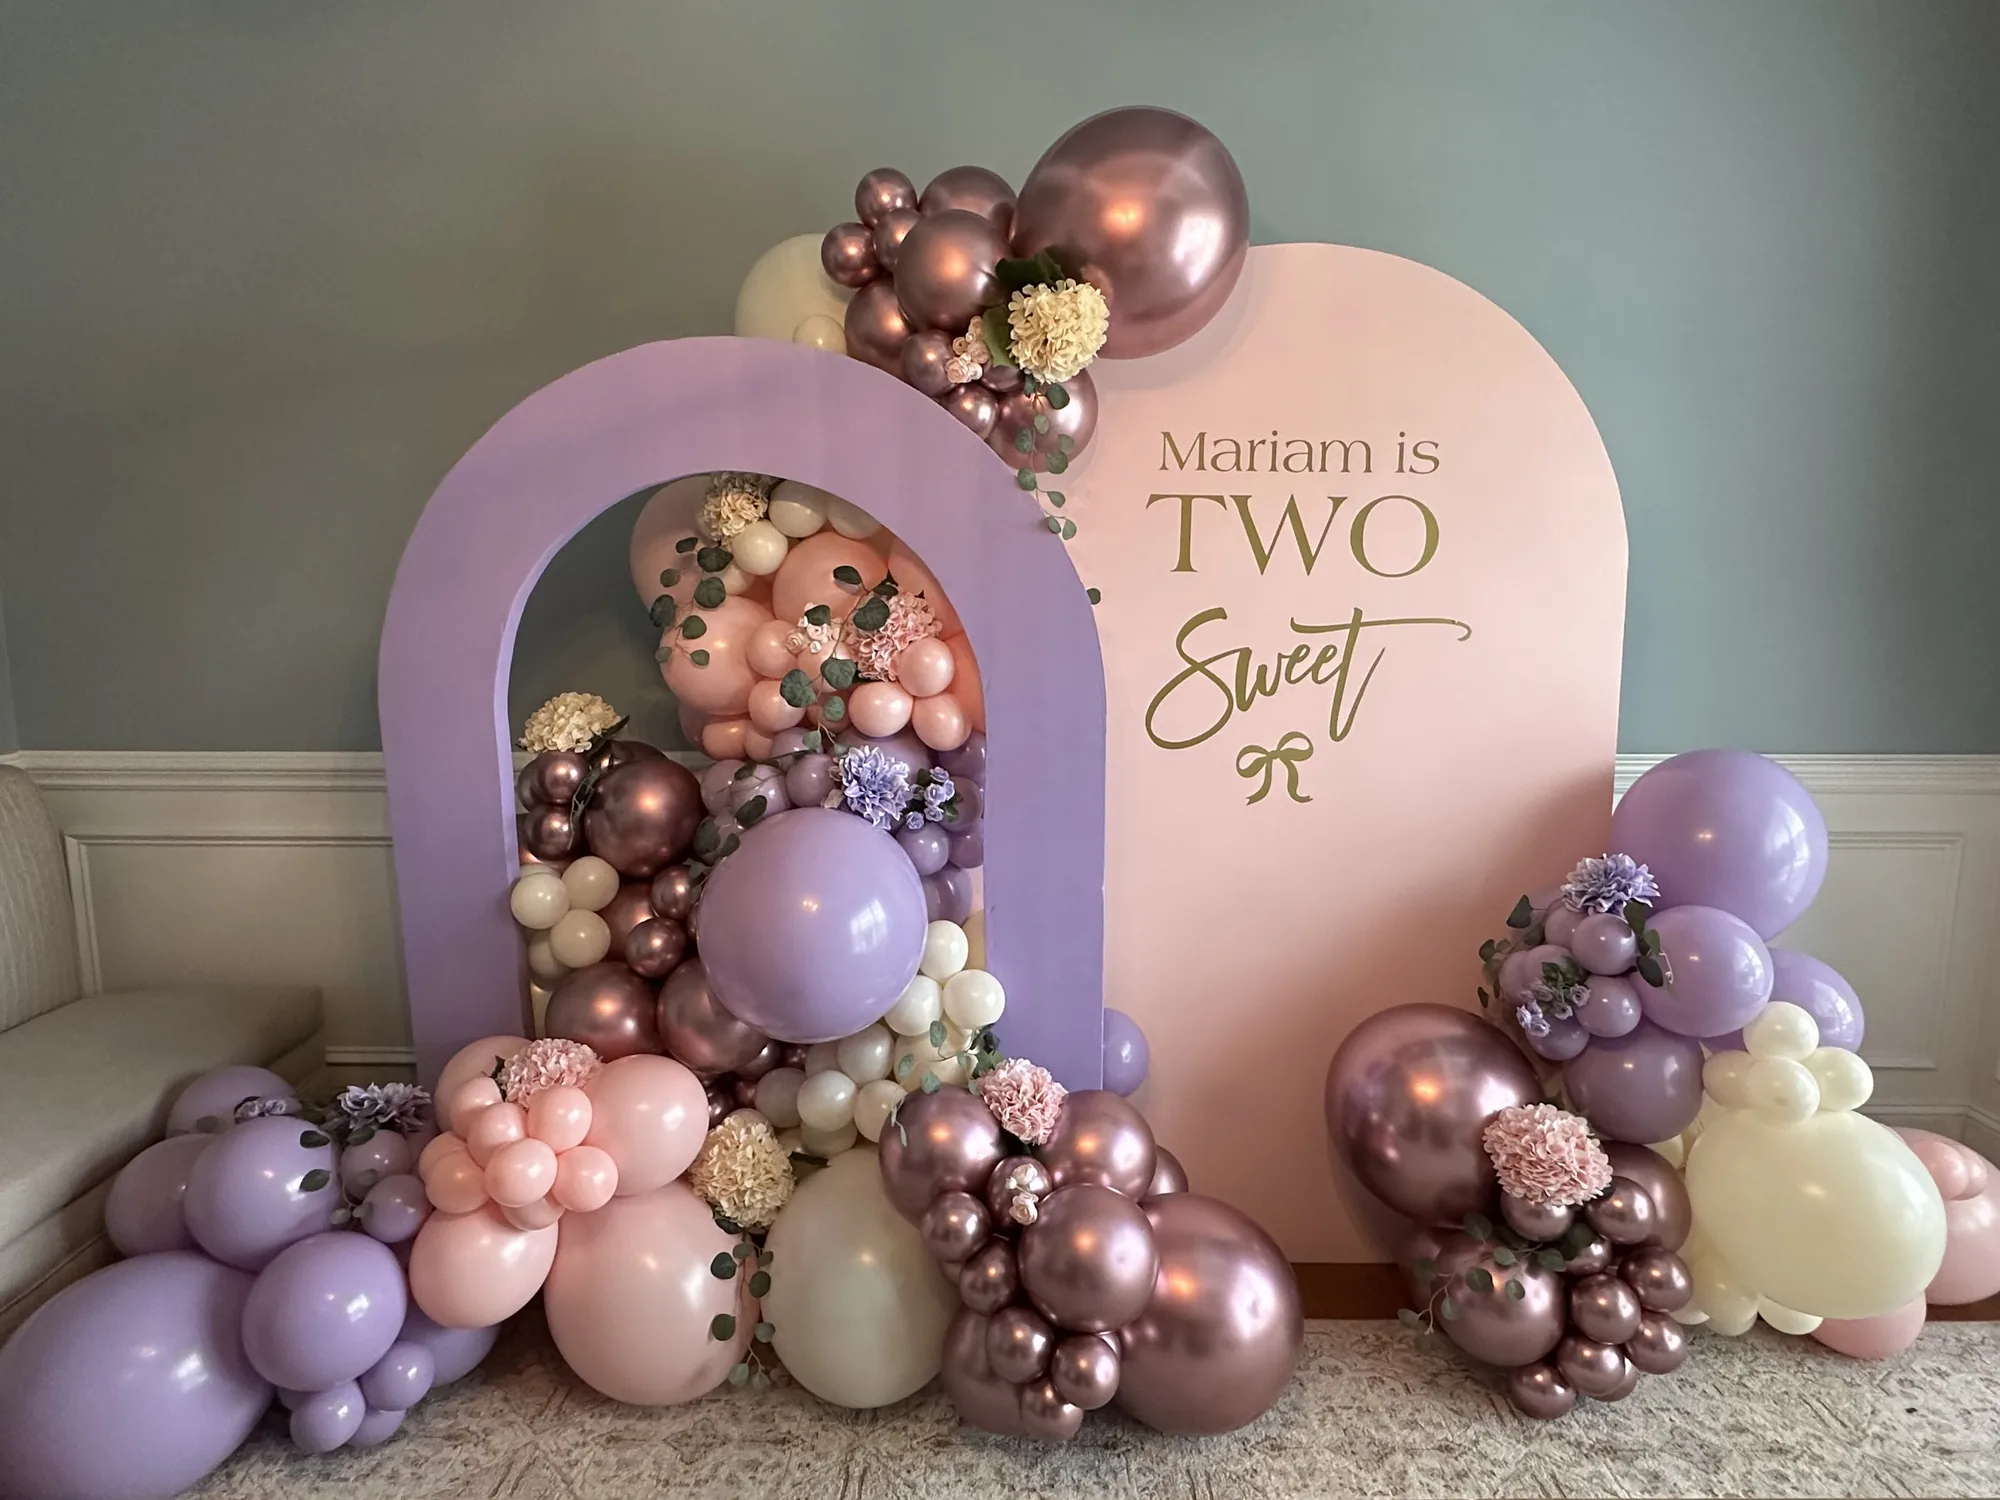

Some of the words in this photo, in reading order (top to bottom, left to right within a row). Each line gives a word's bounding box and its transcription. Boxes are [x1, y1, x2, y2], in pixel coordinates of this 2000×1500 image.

[1158, 430, 1373, 473] Mariam
[1394, 431, 1440, 474] is
[1145, 493, 1440, 578] TWO
[1145, 607, 1472, 750] Sweet
